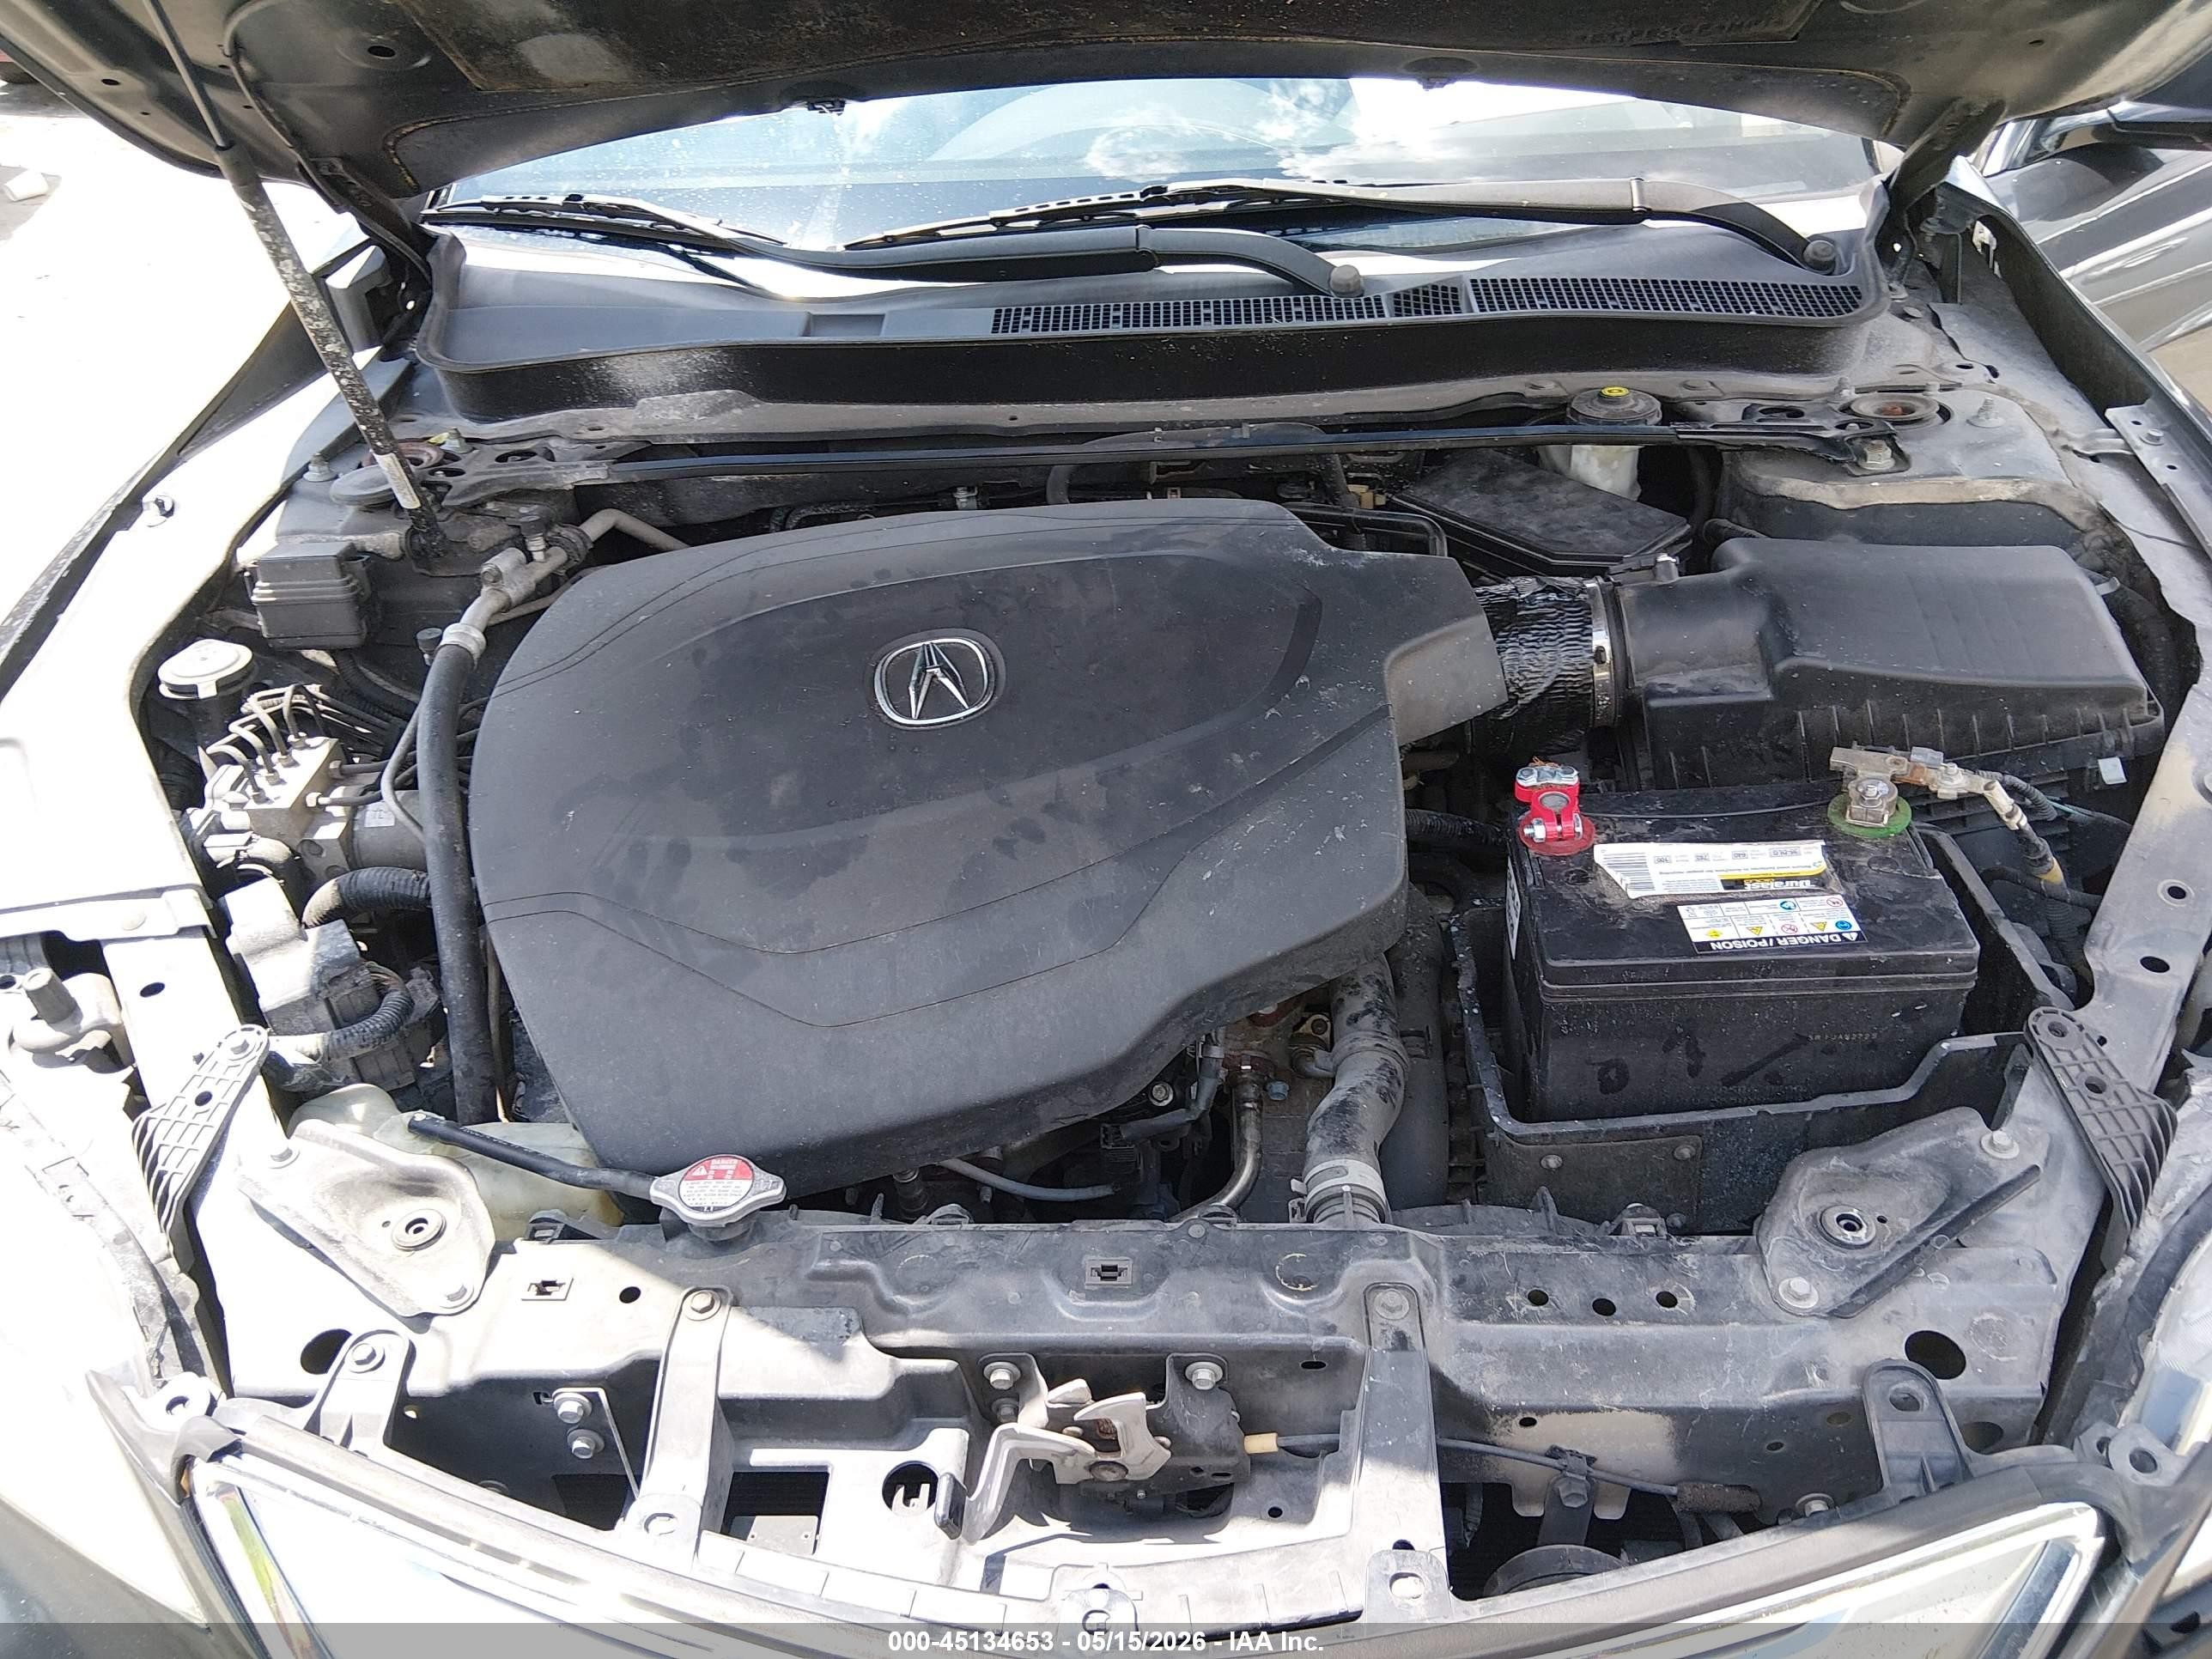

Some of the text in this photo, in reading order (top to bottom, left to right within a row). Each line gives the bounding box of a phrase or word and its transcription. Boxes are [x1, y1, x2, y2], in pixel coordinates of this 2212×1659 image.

[1744, 879, 1815, 890] Duralast
[1710, 938, 1769, 951] POISON
[1776, 933, 1842, 947] DANGER
